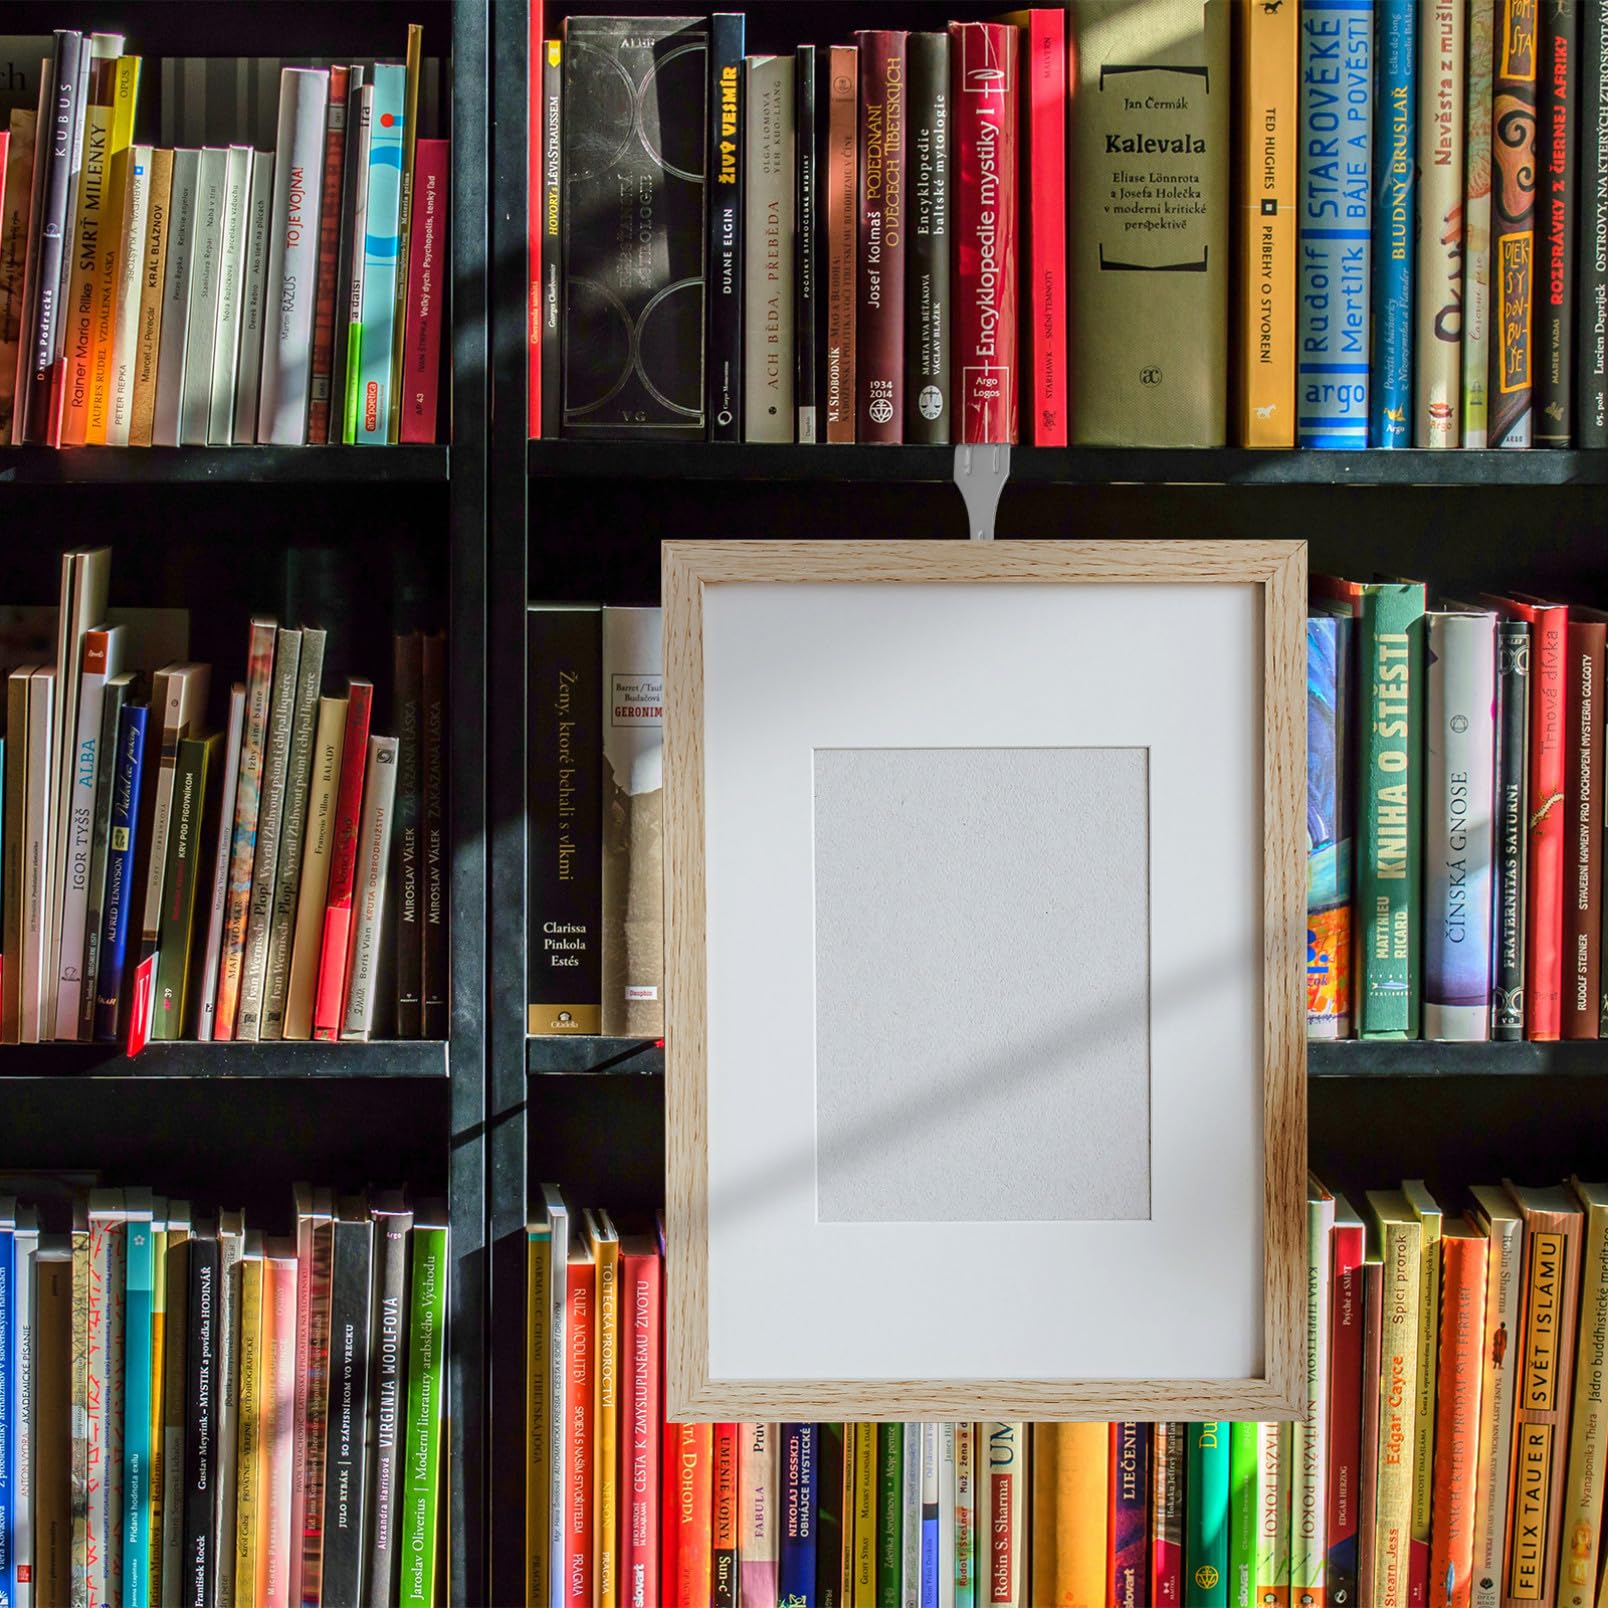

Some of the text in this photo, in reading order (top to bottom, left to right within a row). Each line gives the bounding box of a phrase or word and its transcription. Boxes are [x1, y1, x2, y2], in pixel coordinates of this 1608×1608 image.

[119, 70, 130, 98] OPUS
[1125, 96, 1188, 110] Jan Čermák
[1440, 61, 1452, 70] z
[56, 83, 72, 157] KUBUS
[719, 67, 737, 184] ŽIVÝ VESMÍR
[884, 58, 901, 246] O VĚCECH TIBETSKÝCH
[1105, 134, 1206, 154] Kalevala
[1265, 108, 1276, 189] TED HUGHES
[1304, 18, 1340, 217] STAROVĚKÉ
[1344, 18, 1369, 217] BÁJE A POVĚSTI
[1435, 80, 1453, 166] Nevěsta
[79, 123, 106, 271] SMRŤ MILENKY
[917, 129, 932, 234] Encyklopedie
[933, 95, 947, 234] baltské mytologie
[977, 120, 999, 205] mystiky
[1113, 172, 1199, 183] Eliase Lönnrota
[1120, 188, 1152, 200] Josefa
[1156, 188, 1201, 199] Holečka
[1388, 86, 1408, 260] BLUDNÝ BRUSLAŘ
[1549, 37, 1567, 305] ROZPRÁVKY Z ČIERNEJ AFRIKY
[147, 205, 162, 288] KRÁĽ BLÁZNOV
[286, 167, 304, 248] TO JE VOJNA!
[548, 192, 559, 235] HOVORY
[866, 104, 883, 308] Josef Kolmaš POJEDNÁNÍ
[1165, 203, 1206, 214] kritické
[419, 293, 430, 317] Veľký
[425, 191, 436, 214] tenký
[723, 209, 733, 294] DUANE ELGIN
[976, 211, 999, 356] Encyklopedie
[37, 290, 53, 381] Dana Podracká
[1261, 226, 1273, 363] PRÍBEHY O STVORENÍ
[1304, 246, 1329, 352] Rudolf
[1340, 247, 1364, 352] Mertlík
[72, 283, 93, 408] Rainer Maria Rilke
[767, 354, 780, 390] ACH
[931, 303, 941, 375] VÁCLAV BLAŽEK
[1594, 337, 1605, 374] Lucien
[870, 380, 893, 389] 1934
[870, 390, 893, 398] 2014
[974, 390, 1000, 398] Logos
[976, 377, 999, 385] Argo
[1305, 384, 1365, 413] argo
[78, 739, 96, 788] ALBA
[557, 722, 575, 761] ktoré
[1372, 634, 1408, 878] KNIHA O ŠTĚSTÍ
[177, 773, 194, 858] KRV POD FIGOVNÍKOM
[314, 744, 335, 855] François Villon BALADY
[558, 769, 576, 819] behali
[72, 808, 90, 890] IGOR TYŠŠ
[402, 828, 416, 922] MIROSLAV VÁLEK
[557, 835, 575, 881] vlkmi
[1445, 772, 1468, 943] ČÍNSKÁ GNOSE
[1504, 784, 1518, 968] FRATERNITAS SATURNI
[246, 882, 271, 1001] Ivan Wernisch Plop!
[543, 923, 587, 933] Clarissa
[544, 939, 586, 950] Pinkola
[551, 956, 579, 967] Estés
[1376, 896, 1390, 959] MATTHIEU
[1394, 912, 1407, 959] RICARD
[1577, 934, 1588, 1011] RUDOLF STEINER
[1392, 1235, 1408, 1324] Spící prorok
[1530, 1241, 1557, 1401] SVĚT ISLÁMU
[200, 1320, 213, 1358] povídka
[380, 1297, 398, 1447] VIRGINIA WOOLFOVÁ
[416, 1256, 436, 1480] Moderní literatury arabského Východu
[573, 1288, 586, 1387] RUIZ MODLITBY
[198, 1367, 210, 1407] MYSTIK
[633, 1281, 648, 1492] CESTA K ZMYSLUPLNÉMU ŽIVOTU
[1387, 1356, 1404, 1465] Edgar Cayce
[198, 1458, 208, 1490] Gustav
[199, 1416, 211, 1455] Meyrink
[130, 1477, 139, 1510] hodnota
[339, 1504, 348, 1528] JULO
[754, 1486, 764, 1538] FABULA
[788, 1436, 798, 1537] NIKOLAJ LOSSKIJ:
[799, 1428, 811, 1537] OBHÁJCE MYSTICKÉ
[1520, 1434, 1544, 1589] FELIX TAUER
[129, 1512, 140, 1543] Přidaná
[411, 1498, 425, 1600] Jaroslav Oliverius
[994, 1480, 1009, 1596] Robin S. Sharma
[634, 1564, 645, 1607] slovart
